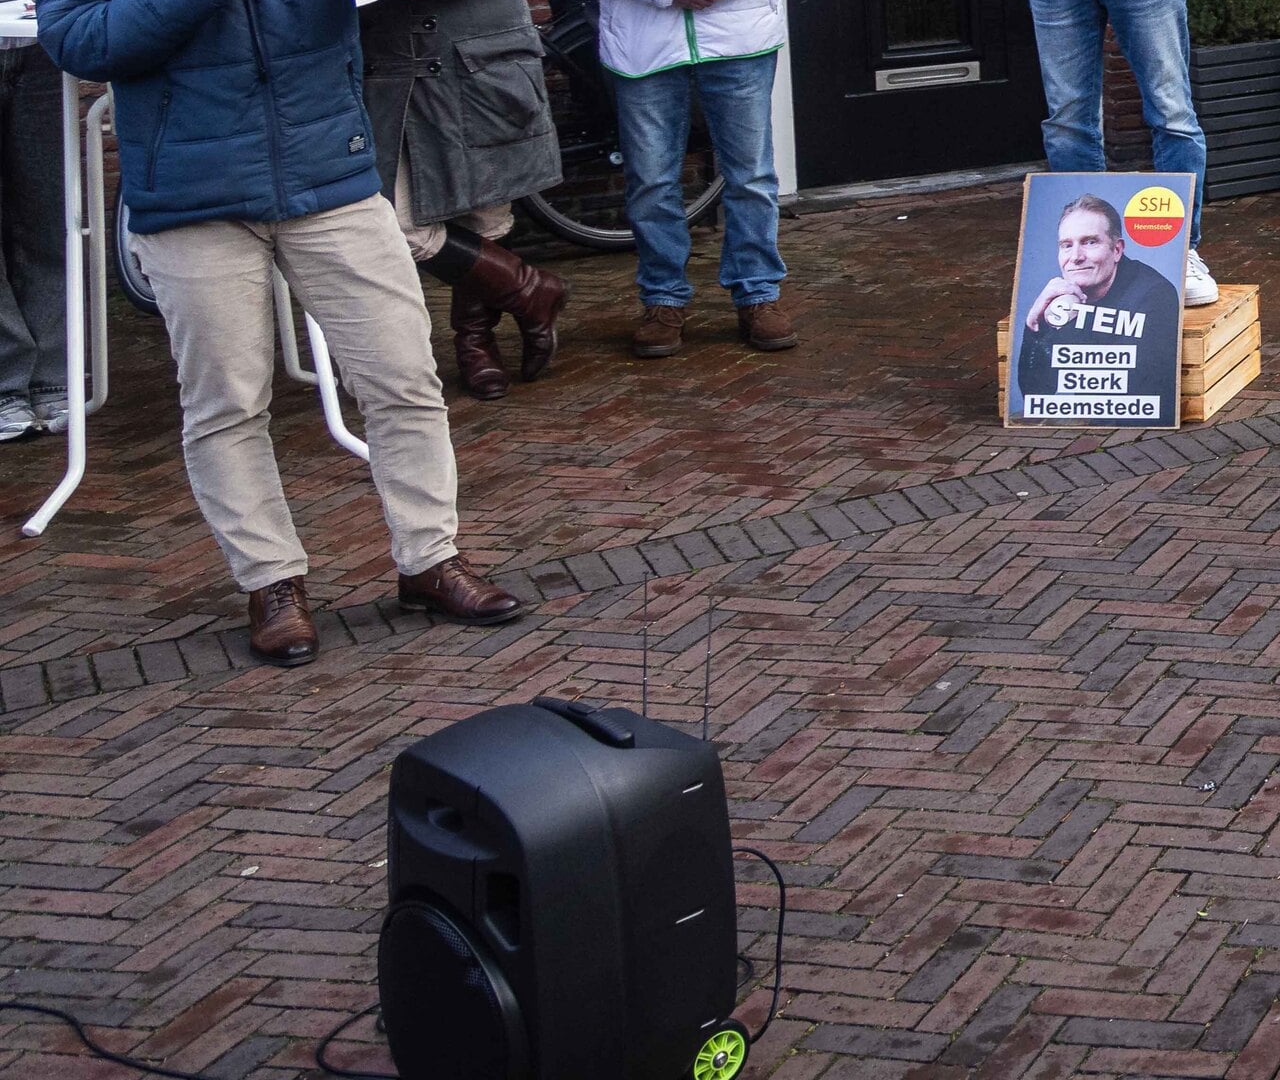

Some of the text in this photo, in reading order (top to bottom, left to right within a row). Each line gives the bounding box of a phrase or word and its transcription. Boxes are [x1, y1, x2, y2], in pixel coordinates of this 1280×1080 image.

[1139, 197, 1171, 212] SSH
[1133, 223, 1173, 232] Heemstede
[1047, 302, 1146, 338] STEM
[1056, 347, 1131, 365] Samen
[1063, 372, 1122, 390] Sterk
[1029, 397, 1155, 416] Heemstede
